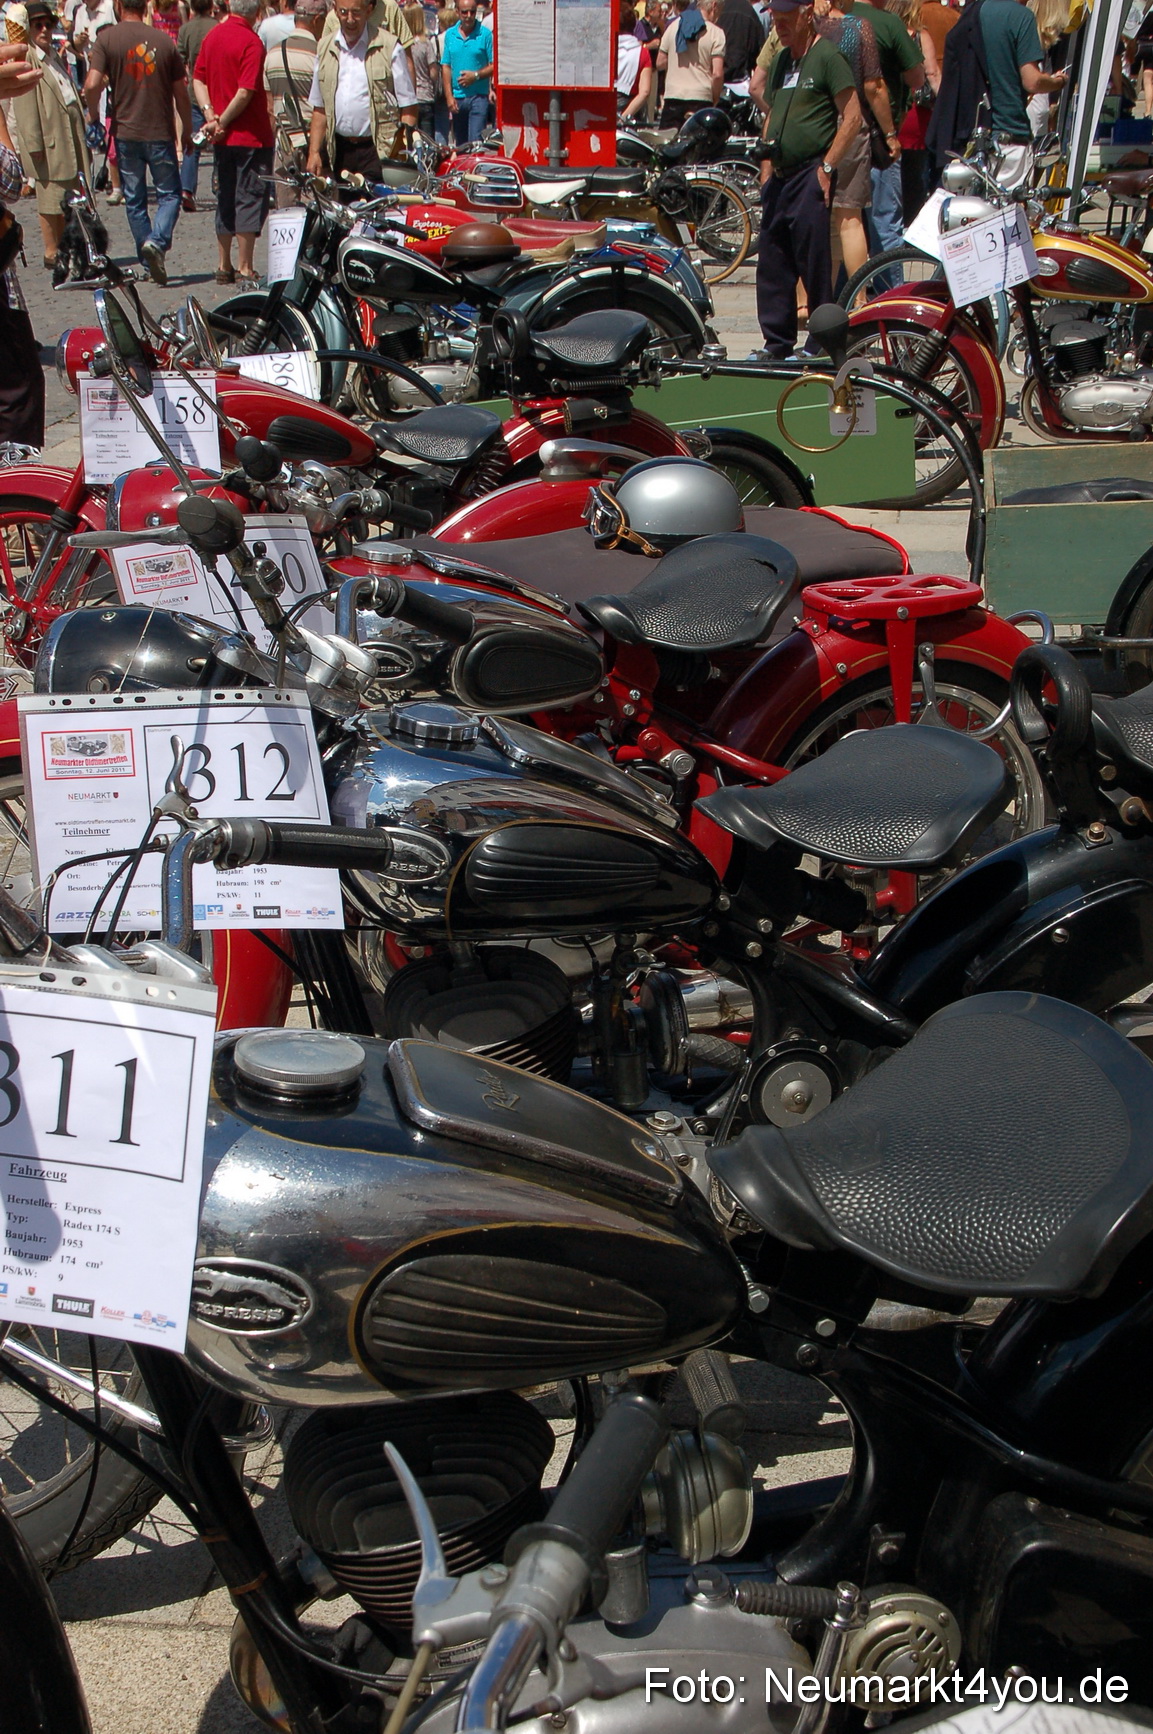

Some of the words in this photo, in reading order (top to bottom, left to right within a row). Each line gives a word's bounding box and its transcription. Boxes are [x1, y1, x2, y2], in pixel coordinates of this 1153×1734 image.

[271, 227, 296, 247] 288
[985, 221, 1022, 252] 314
[158, 396, 206, 425] 158
[51, 757, 84, 767] Neumarkter
[184, 741, 297, 804] 312
[68, 792, 112, 800] NEUMARKT
[62, 828, 111, 837] Teilnehmer
[389, 861, 428, 873] RESS
[255, 908, 279, 916] THULE
[8, 1163, 67, 1183] Fahrzeug
[7, 1194, 58, 1209] Hersteller:
[64, 1202, 102, 1215] Express
[6, 1211, 29, 1224] Typ:
[63, 1219, 93, 1232] Radex
[96, 1224, 112, 1235] 174
[114, 1227, 121, 1236] S
[5, 1229, 47, 1244] Baujahr:
[61, 1238, 84, 1249] 1953
[3, 1247, 52, 1262] Hubraum:
[60, 1255, 76, 1265] 174
[2, 1264, 38, 1278] PS/kW:
[58, 1273, 64, 1282] 9
[56, 1298, 92, 1313] THULE
[194, 1301, 285, 1322] XPRESS
